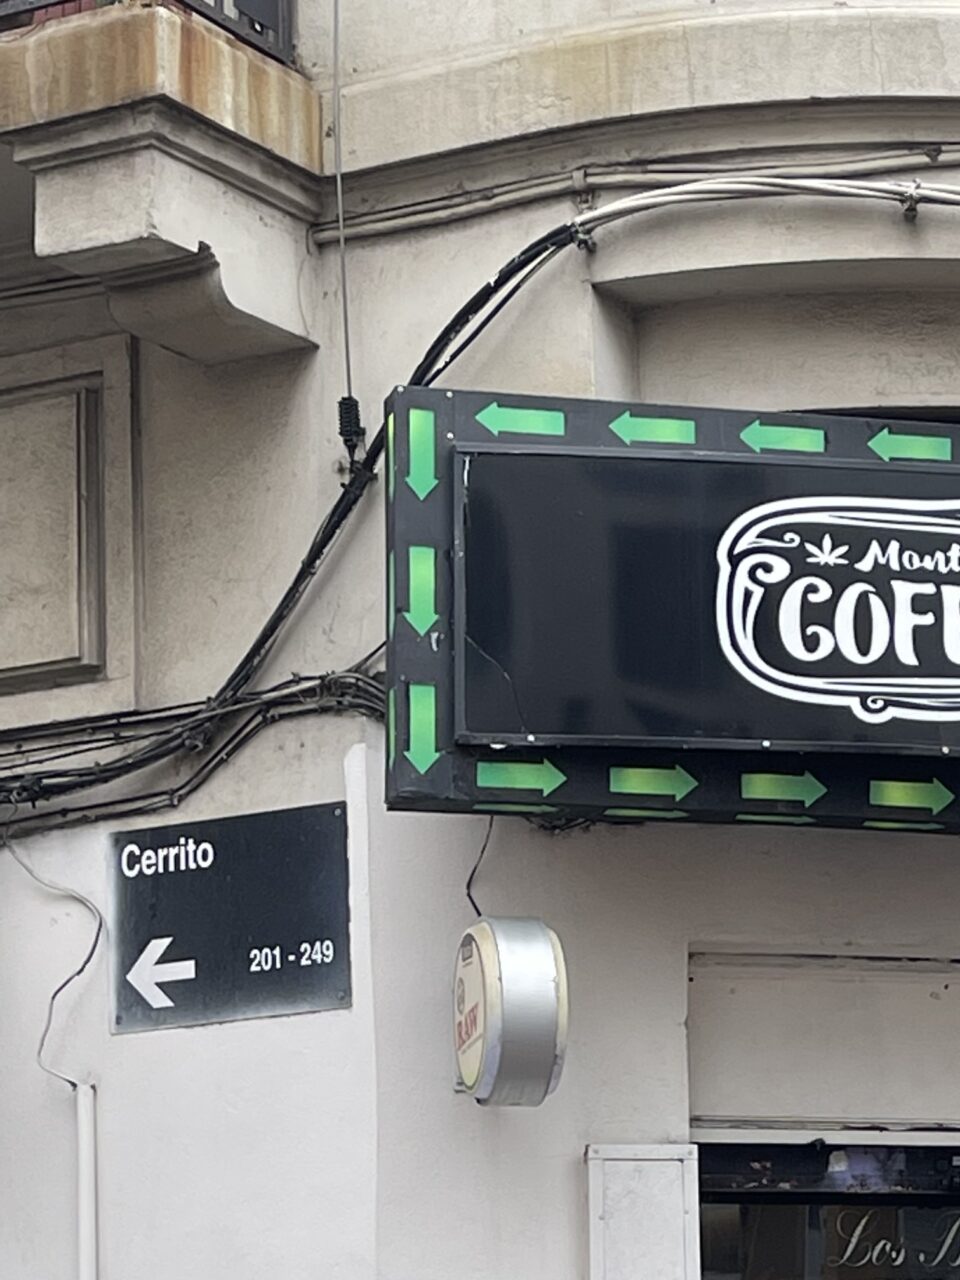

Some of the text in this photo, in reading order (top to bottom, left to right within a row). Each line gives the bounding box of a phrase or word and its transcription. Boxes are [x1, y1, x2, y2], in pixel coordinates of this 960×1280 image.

[121, 837, 215, 878] Cerrito
[249, 945, 283, 973] 201
[299, 939, 334, 967] 249
[827, 1207, 906, 1267] Los
